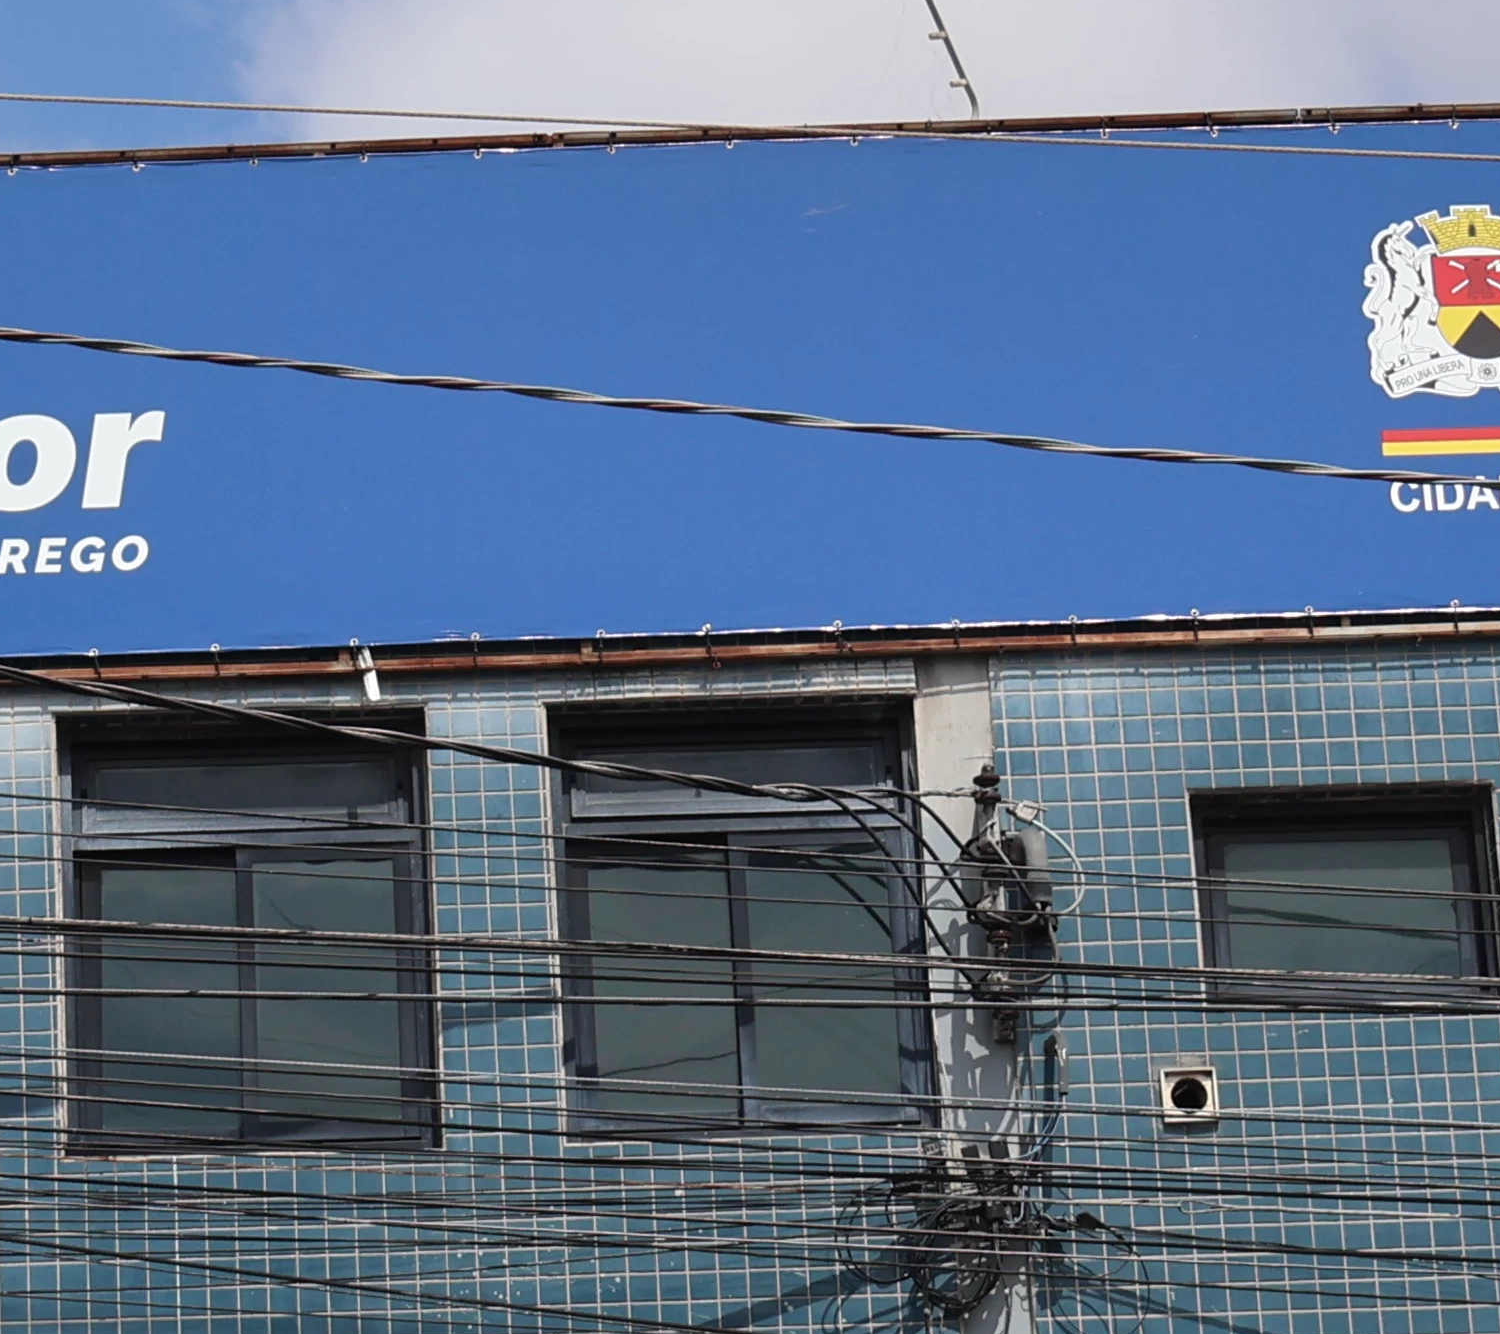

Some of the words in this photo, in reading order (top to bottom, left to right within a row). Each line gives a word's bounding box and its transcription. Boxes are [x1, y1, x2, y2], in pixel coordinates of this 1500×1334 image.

[1395, 374, 1414, 391] PRO
[1413, 367, 1433, 382] UNA
[1432, 359, 1465, 375] LIBERA
